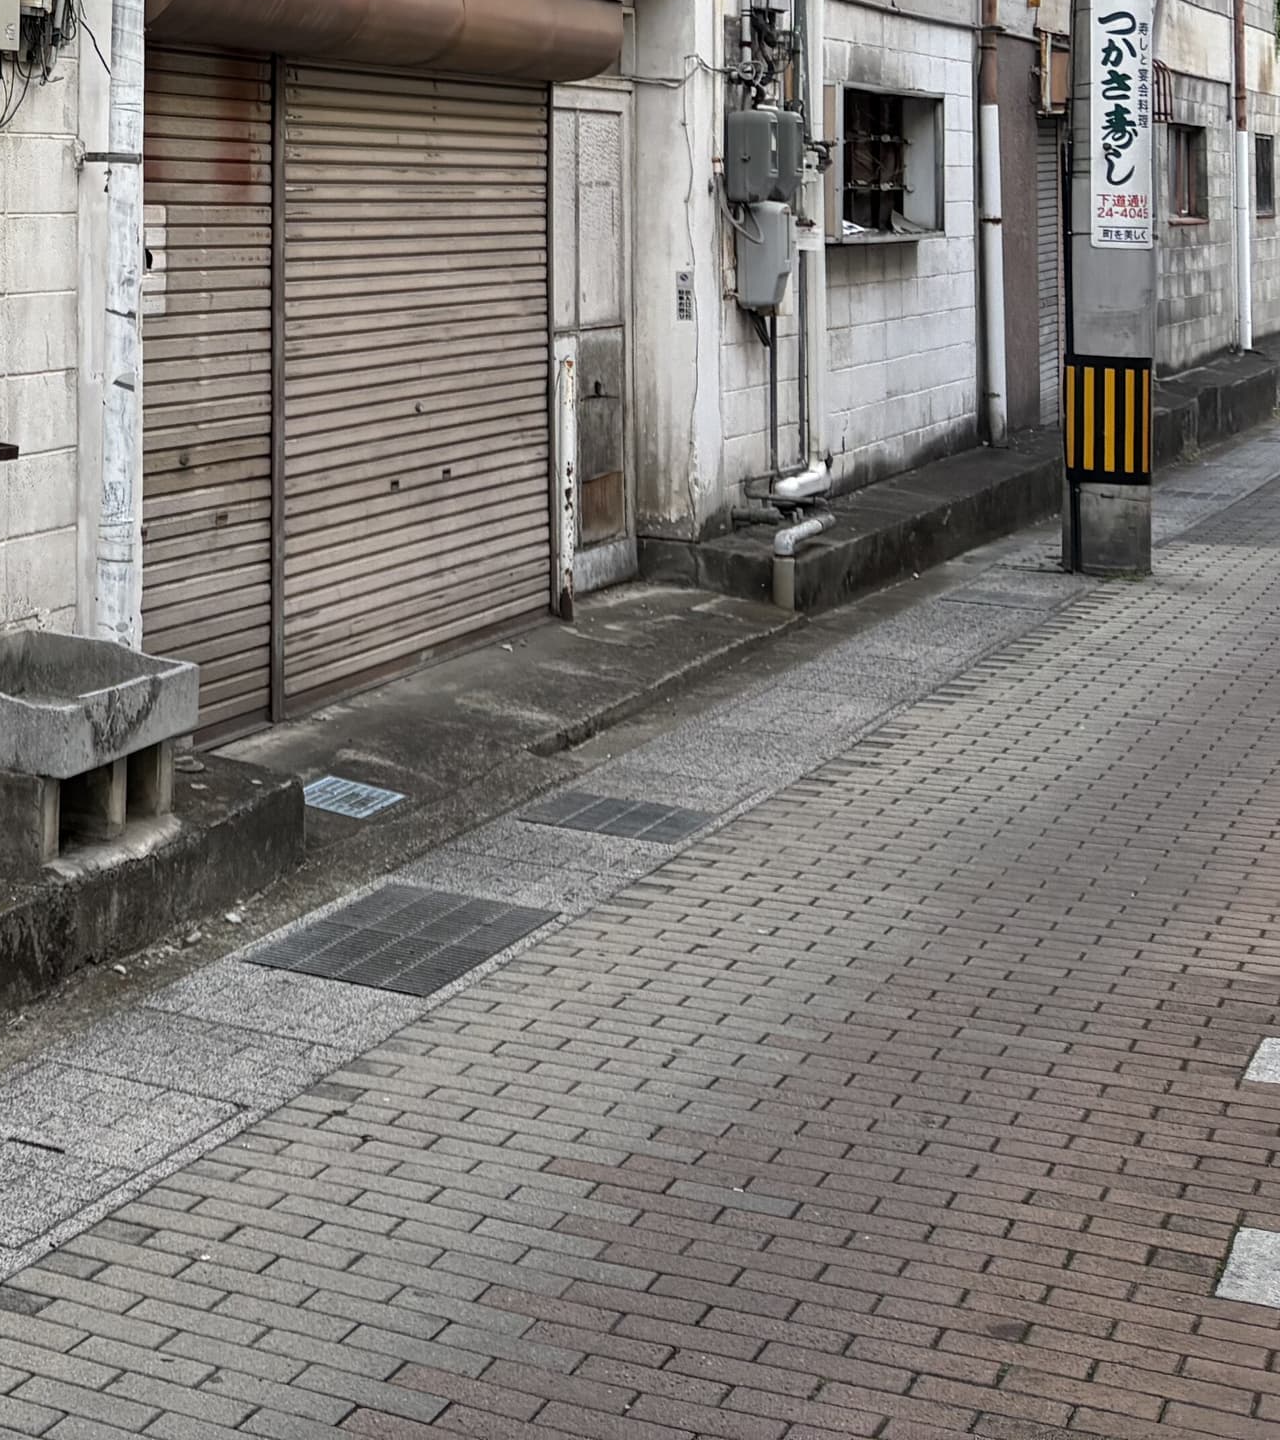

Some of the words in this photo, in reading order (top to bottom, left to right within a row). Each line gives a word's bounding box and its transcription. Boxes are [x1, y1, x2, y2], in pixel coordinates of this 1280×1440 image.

[1098, 11, 1138, 186] つかさ寿し
[1102, 229, 1147, 240] 町を美しく
